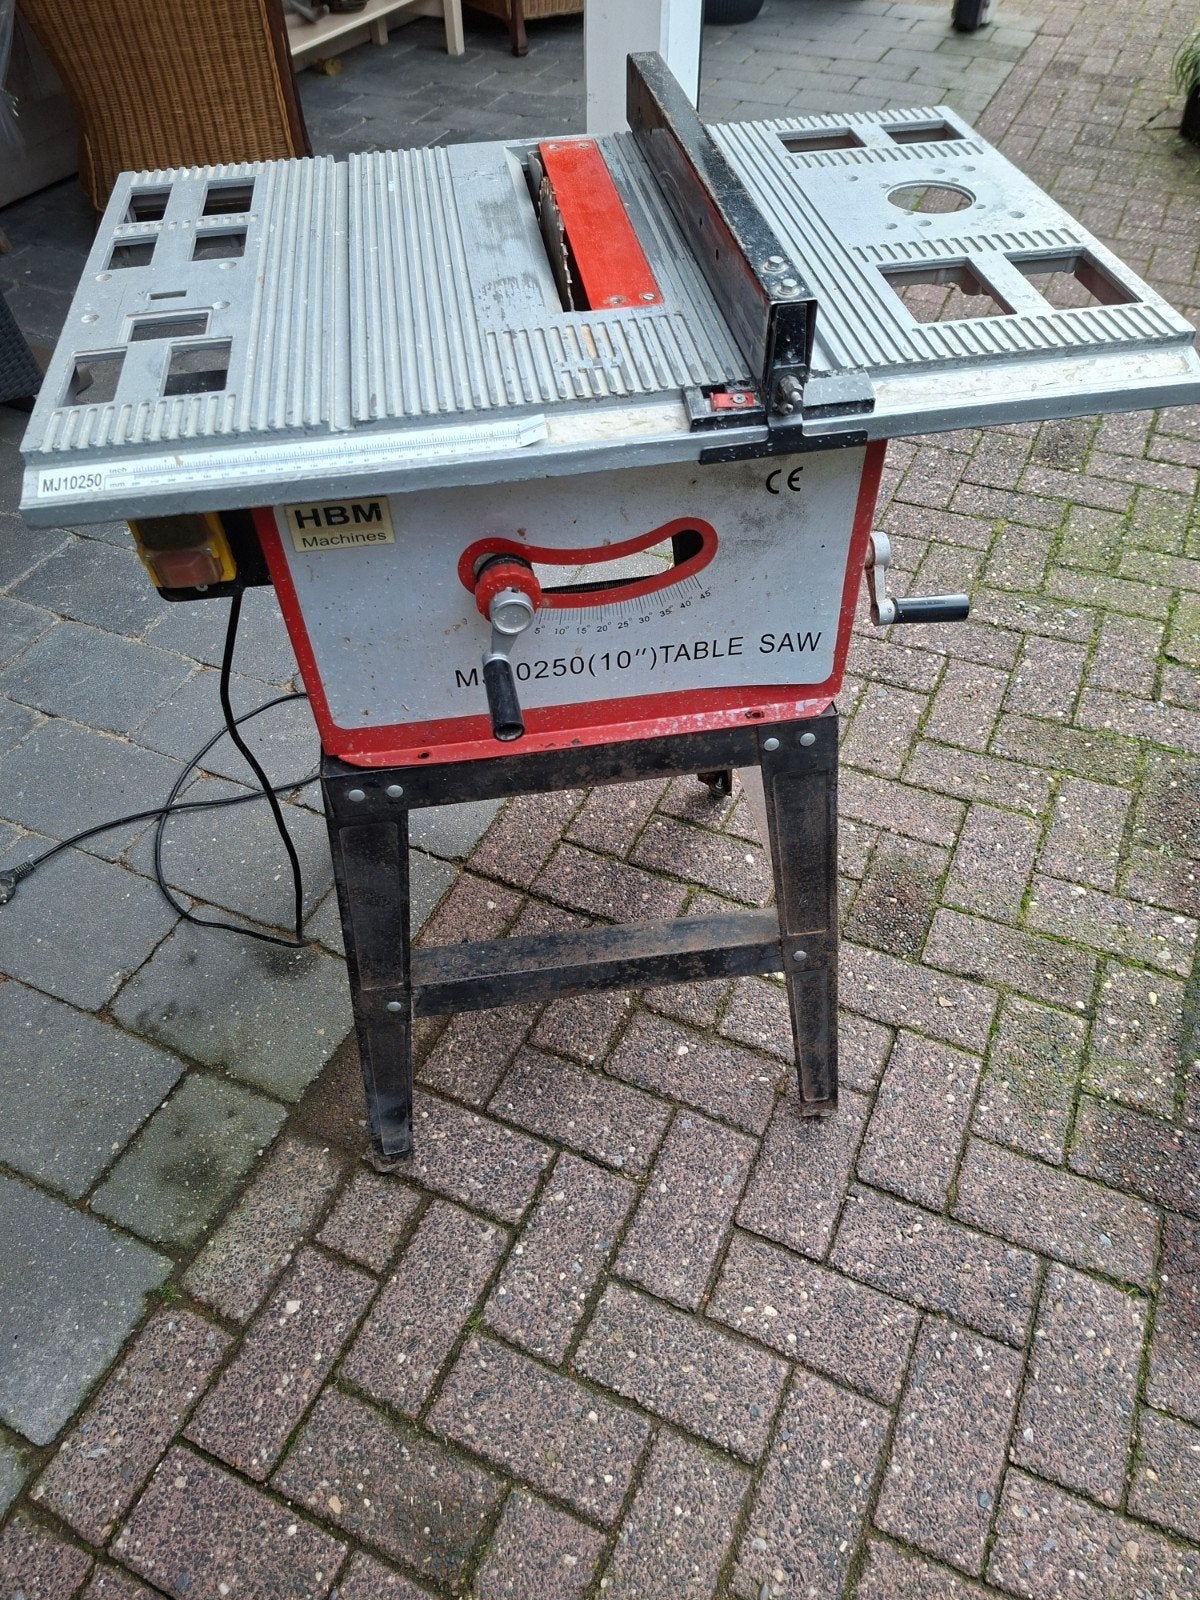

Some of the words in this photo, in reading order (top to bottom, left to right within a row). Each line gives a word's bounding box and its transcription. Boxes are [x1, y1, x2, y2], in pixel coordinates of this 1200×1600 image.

[42, 473, 103, 493] MJ10250
[766, 466, 803, 494] CE
[294, 503, 382, 529] HBM
[302, 532, 387, 548] Machines
[554, 626, 570, 635] 10°
[576, 625, 592, 635] 15°
[596, 621, 612, 633] 20°
[617, 618, 633, 629] 25°
[638, 611, 653, 623] 30°
[679, 597, 693, 609] 40°
[699, 586, 712, 600] 45°
[759, 632, 822, 653] SAW
